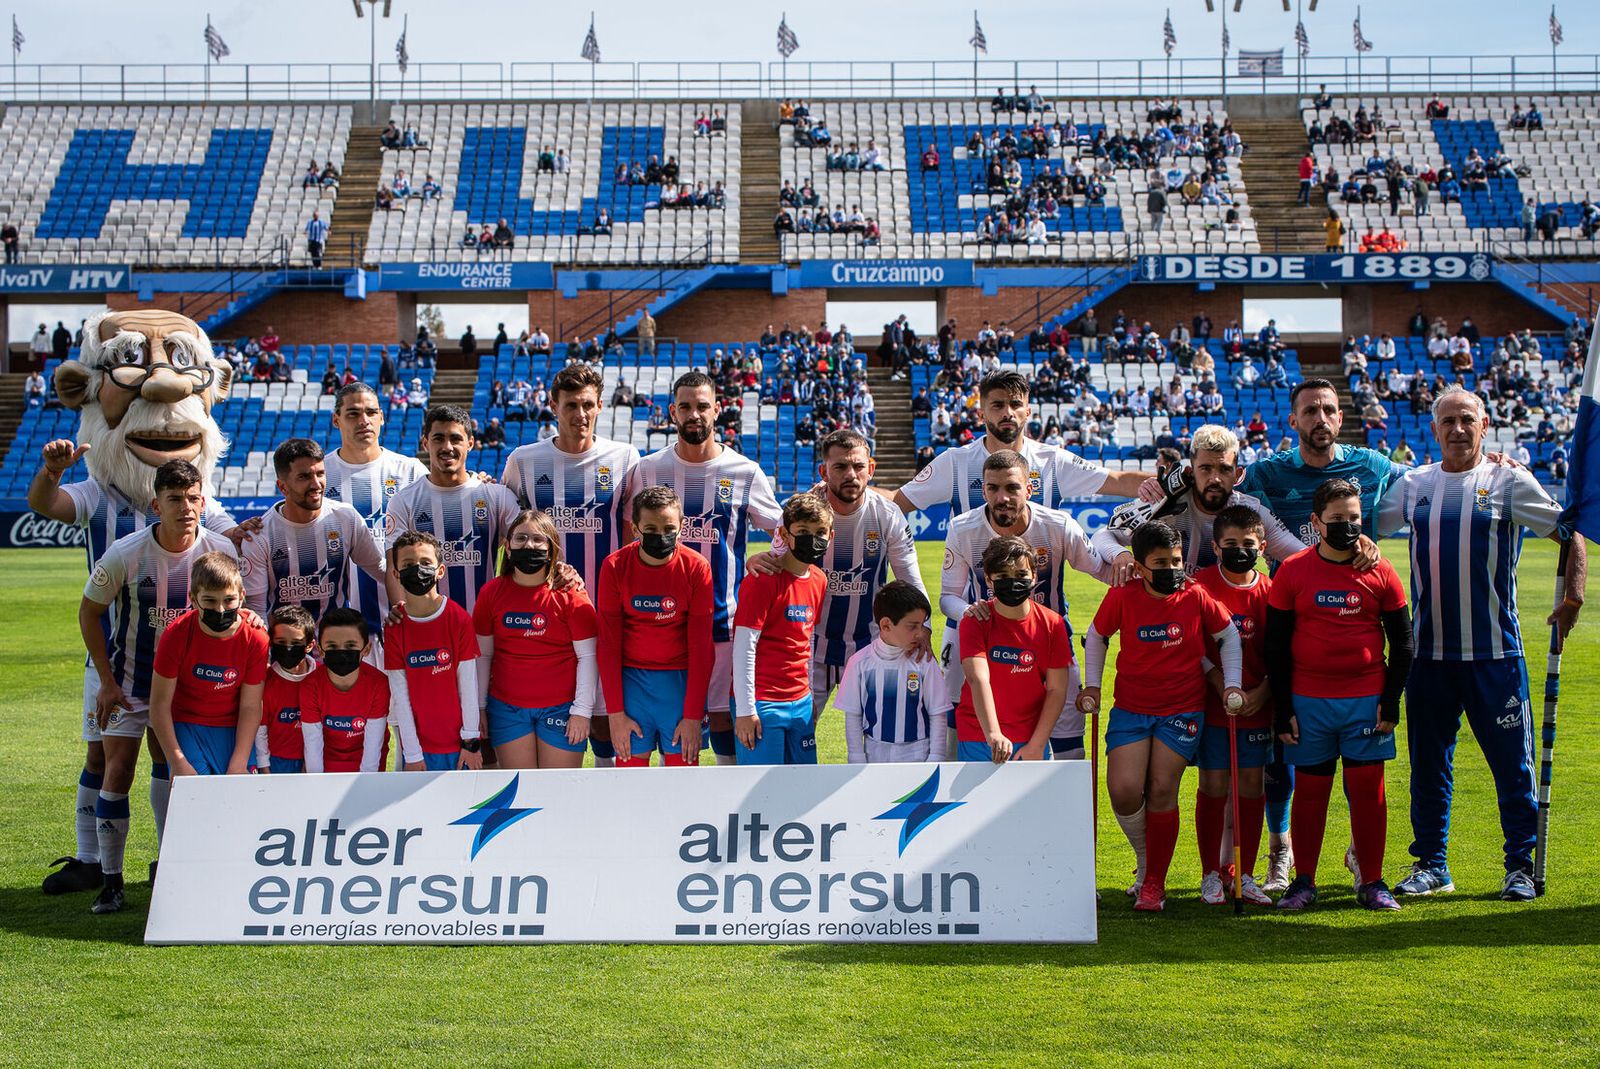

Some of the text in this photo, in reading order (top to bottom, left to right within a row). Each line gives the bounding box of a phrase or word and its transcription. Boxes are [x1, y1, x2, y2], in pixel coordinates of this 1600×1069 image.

[418, 263, 513, 277] ENDURANCE
[831, 262, 944, 285] Cruzcampo
[1165, 255, 1467, 279] DESDE 1889
[0, 268, 124, 290] lvaTV HTV
[461, 277, 512, 288] CENTER
[553, 516, 603, 529] nersun
[279, 575, 311, 588] alter
[280, 582, 335, 598] enersun
[643, 600, 660, 608] Club
[505, 616, 531, 625] El Club
[1140, 630, 1166, 638] El Club
[419, 654, 436, 663] Club
[992, 650, 1018, 660] El Club
[196, 667, 223, 678] El Club
[326, 718, 351, 728] El Club
[254, 818, 422, 866] alter
[678, 812, 847, 864] alter
[248, 873, 548, 915] enersun
[677, 870, 980, 914] enersun
[290, 920, 497, 940] energías renovables
[722, 919, 932, 939] energías renovables
